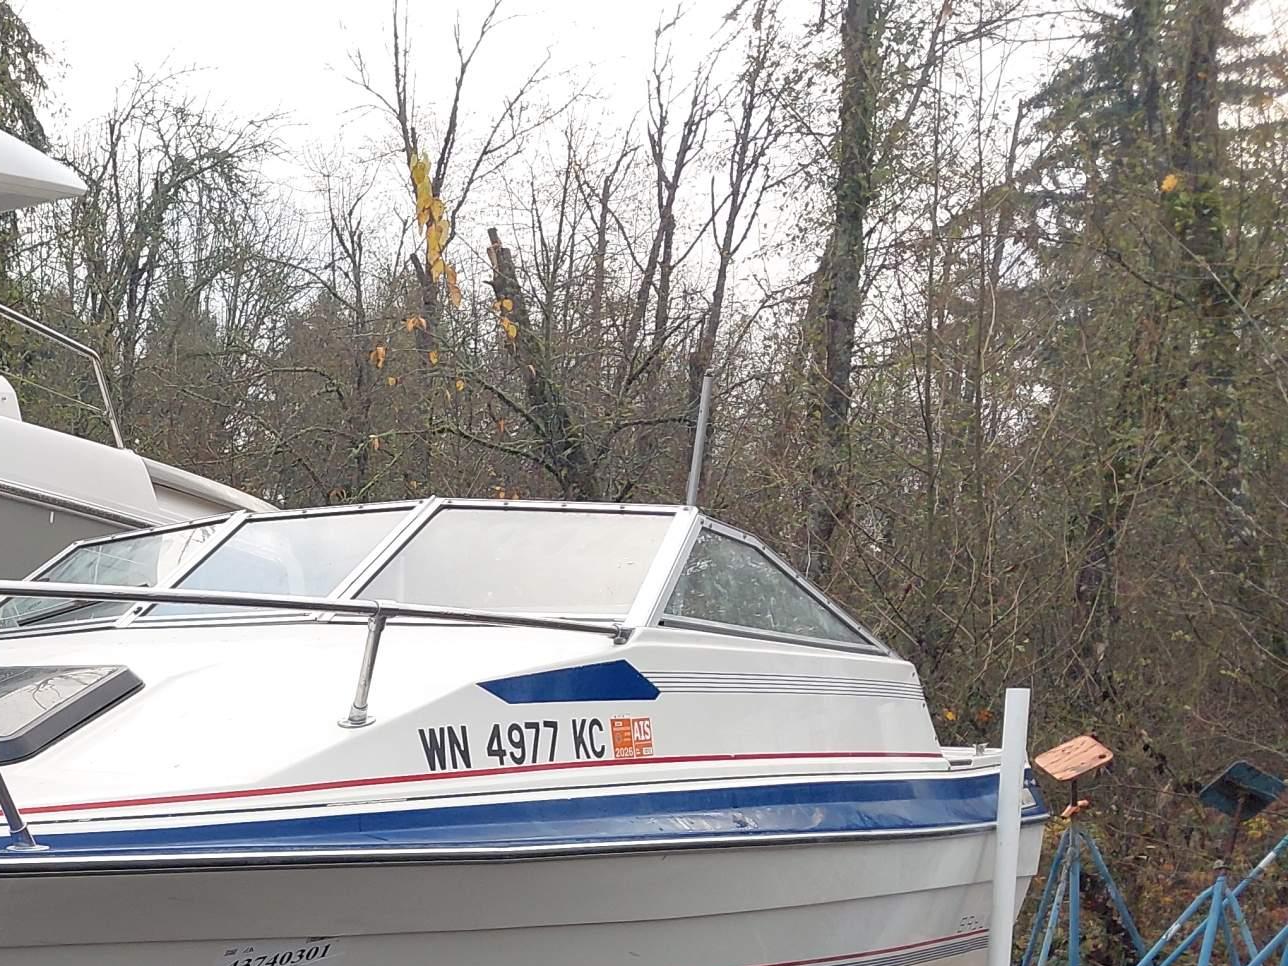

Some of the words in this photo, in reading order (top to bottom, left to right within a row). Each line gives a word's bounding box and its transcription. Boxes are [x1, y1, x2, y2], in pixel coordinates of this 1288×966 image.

[418, 725, 472, 772] WN
[487, 720, 558, 766] 4977
[572, 718, 605, 760] KC
